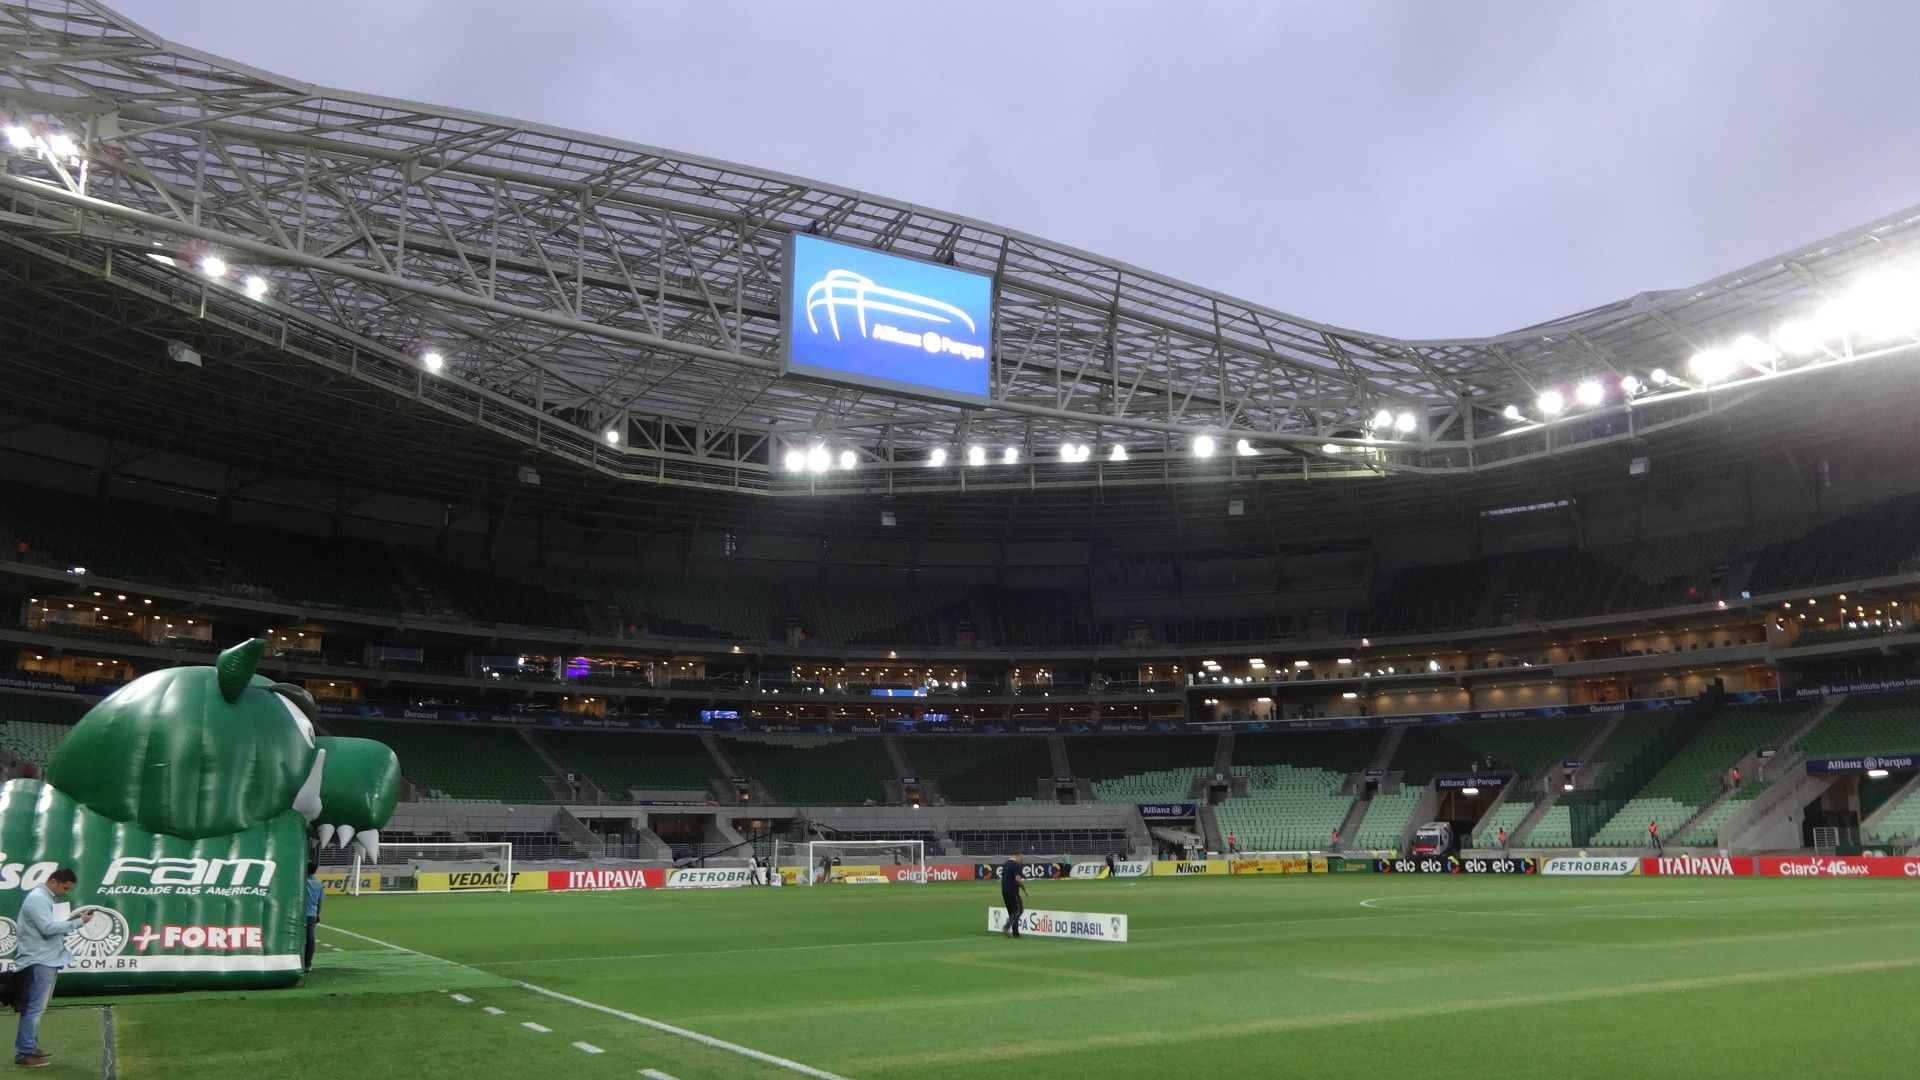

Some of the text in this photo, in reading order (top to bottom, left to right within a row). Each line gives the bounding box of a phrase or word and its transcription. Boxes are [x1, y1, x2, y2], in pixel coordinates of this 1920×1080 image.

[873, 324, 983, 359] Allianz Parque
[1828, 757, 1911, 770] Allianz Parque
[1440, 778, 1502, 787] Allianz Parque
[1143, 806, 1170, 814] Allianz
[1022, 864, 1045, 878] elo
[1176, 862, 1206, 873] Nikon
[1395, 860, 1441, 872] elo elo
[1465, 860, 1514, 872] elo elo
[1551, 861, 1628, 872] PETROBRAS
[1658, 858, 1734, 875] ITAIPAVA
[1780, 858, 1819, 875] Claro
[449, 872, 519, 886] VEDACIT
[569, 870, 646, 888] ITAIPAVA
[97, 885, 171, 896] FACULDADE
[176, 886, 201, 895] DAS
[1030, 913, 1053, 932] Sadia
[1055, 920, 1067, 931] DO
[1071, 921, 1104, 935] BRASIL
